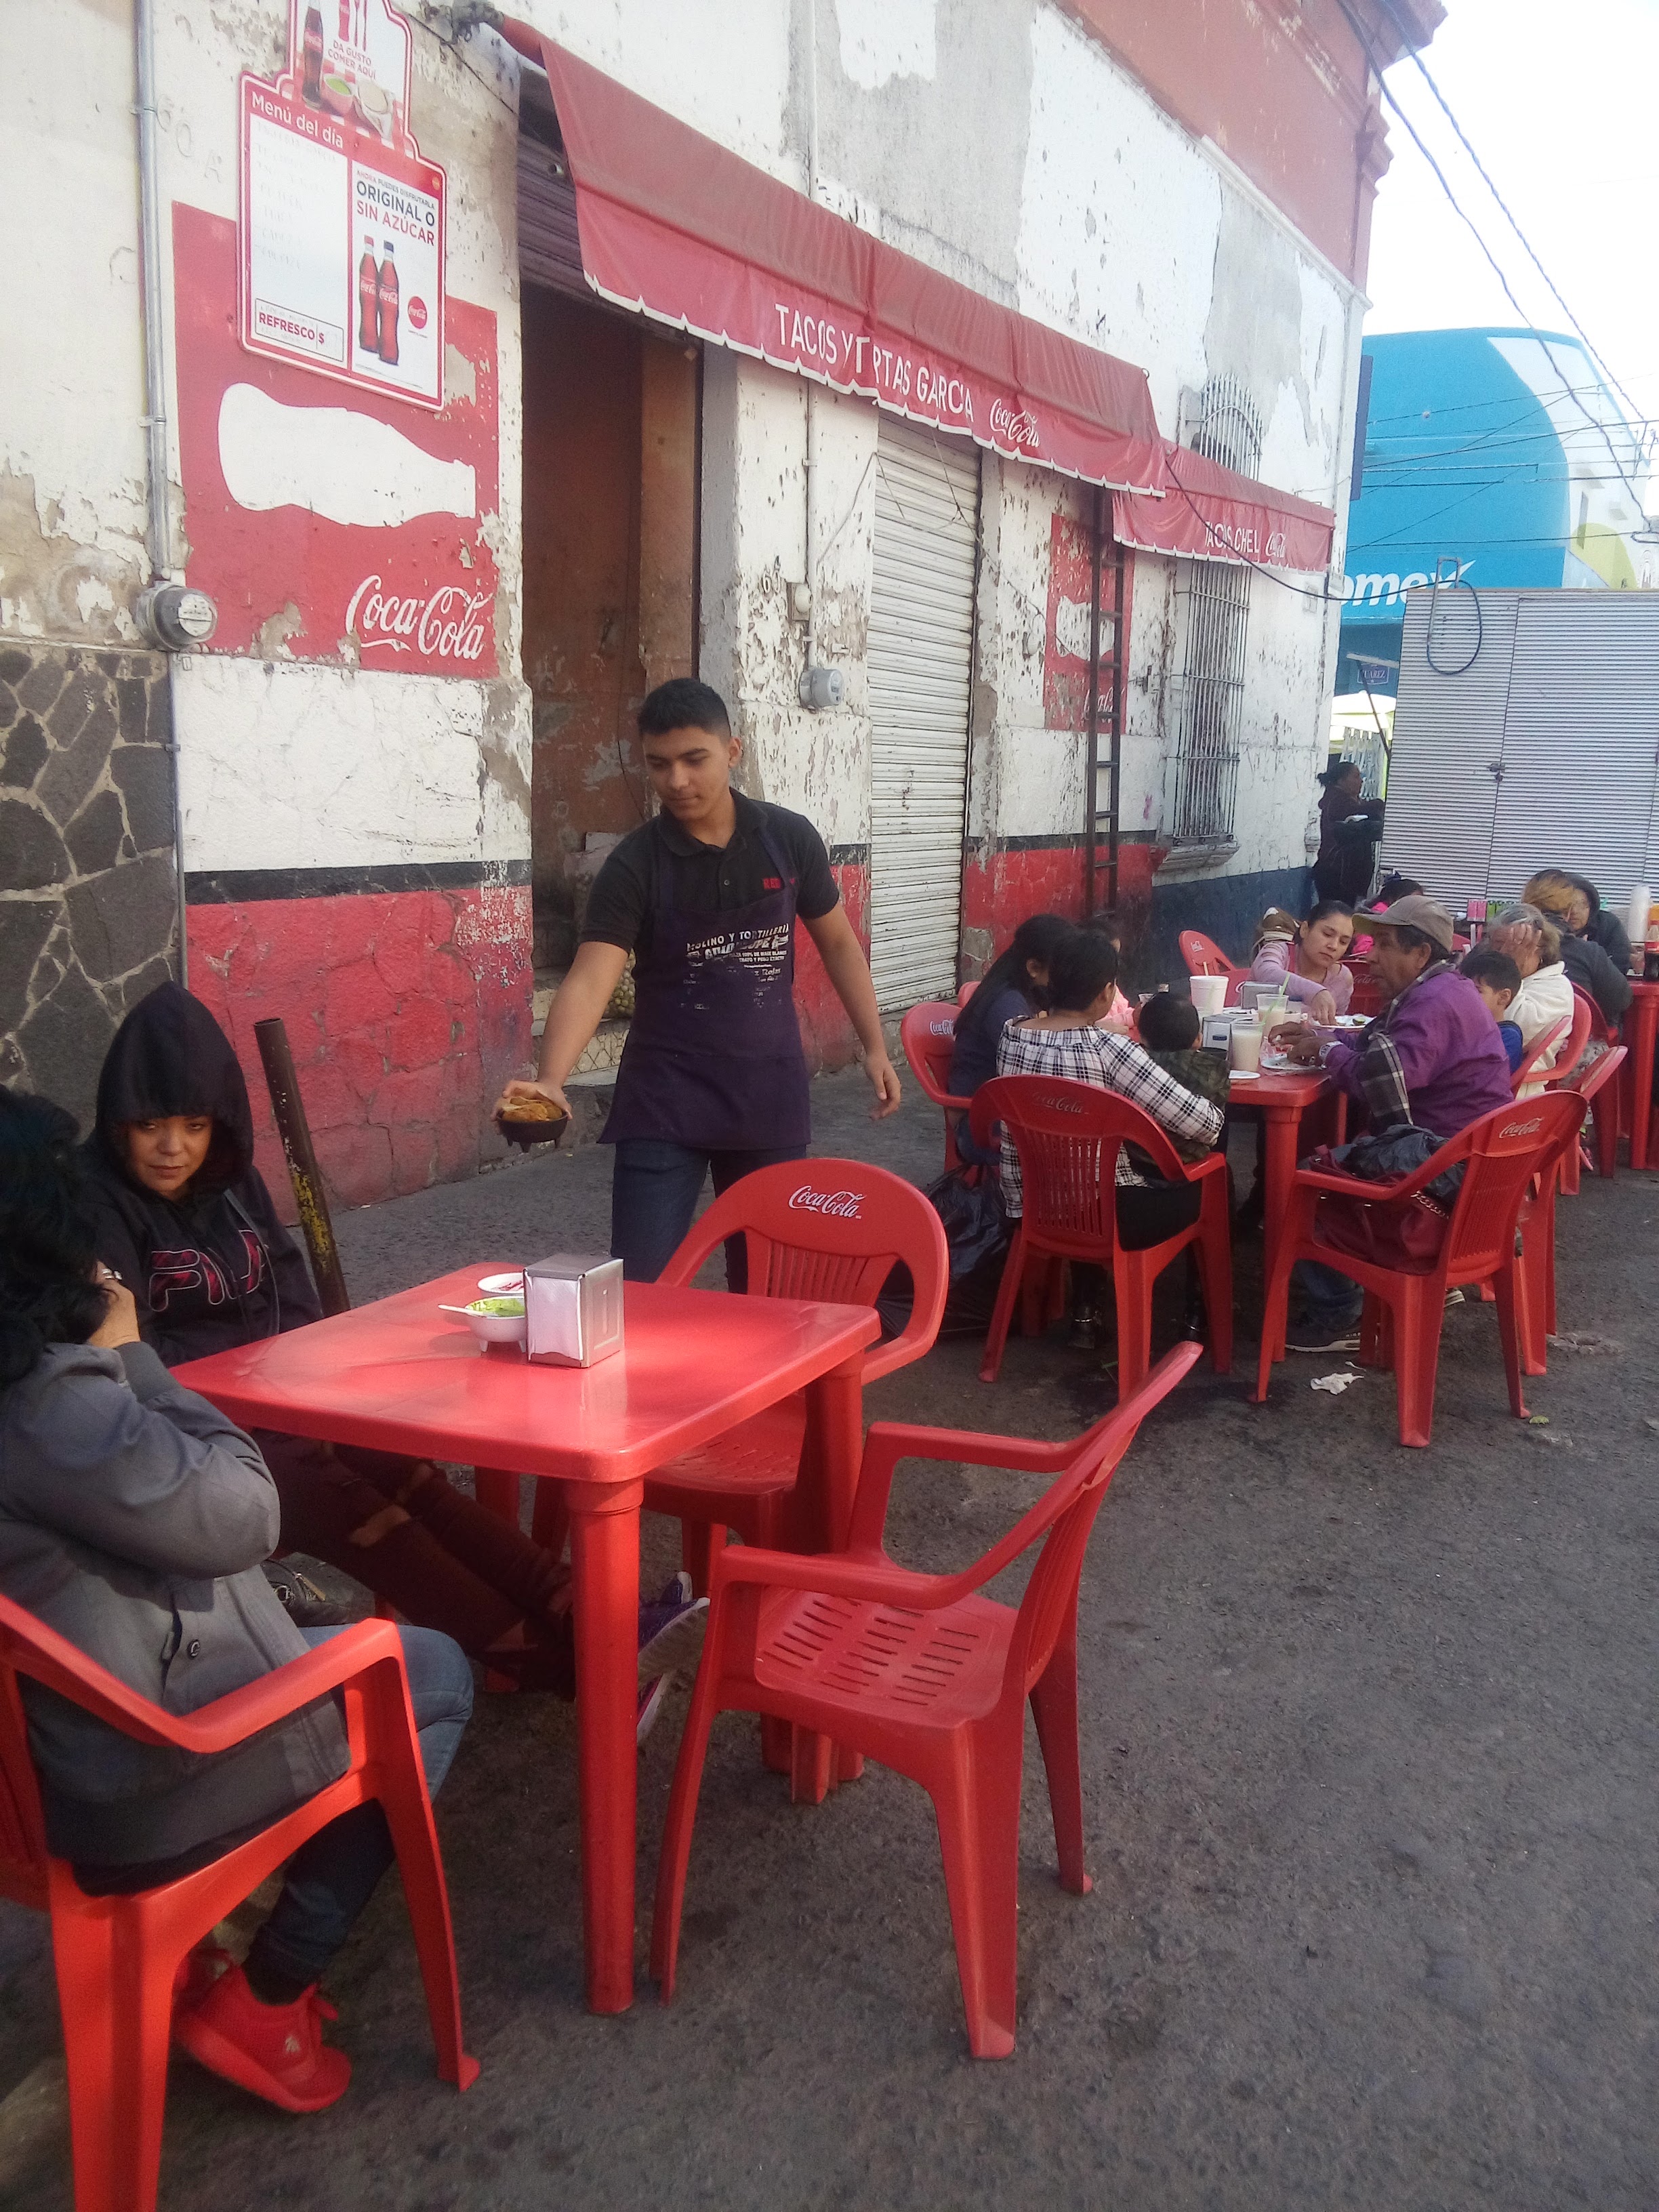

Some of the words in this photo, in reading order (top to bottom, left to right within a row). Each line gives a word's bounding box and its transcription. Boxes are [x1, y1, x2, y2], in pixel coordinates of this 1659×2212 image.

[328, 49, 355, 69] COMER
[333, 40, 344, 53] DA
[346, 48, 371, 66] GUSTO
[251, 91, 292, 125] Menú
[296, 114, 319, 137] del
[356, 180, 422, 222] ORIGINAL
[426, 211, 434, 227] O
[356, 200, 378, 222] SIN
[382, 211, 434, 247] AZÚCAR
[259, 312, 315, 340] REFRESCO
[775, 303, 838, 364] TACOS
[841, 329, 853, 369] Y
[989, 398, 1041, 448] Coca-Cola
[345, 575, 493, 661] Coca-Cola
[729, 933, 735, 942] Y
[788, 1185, 867, 1218] Coca-Cola
